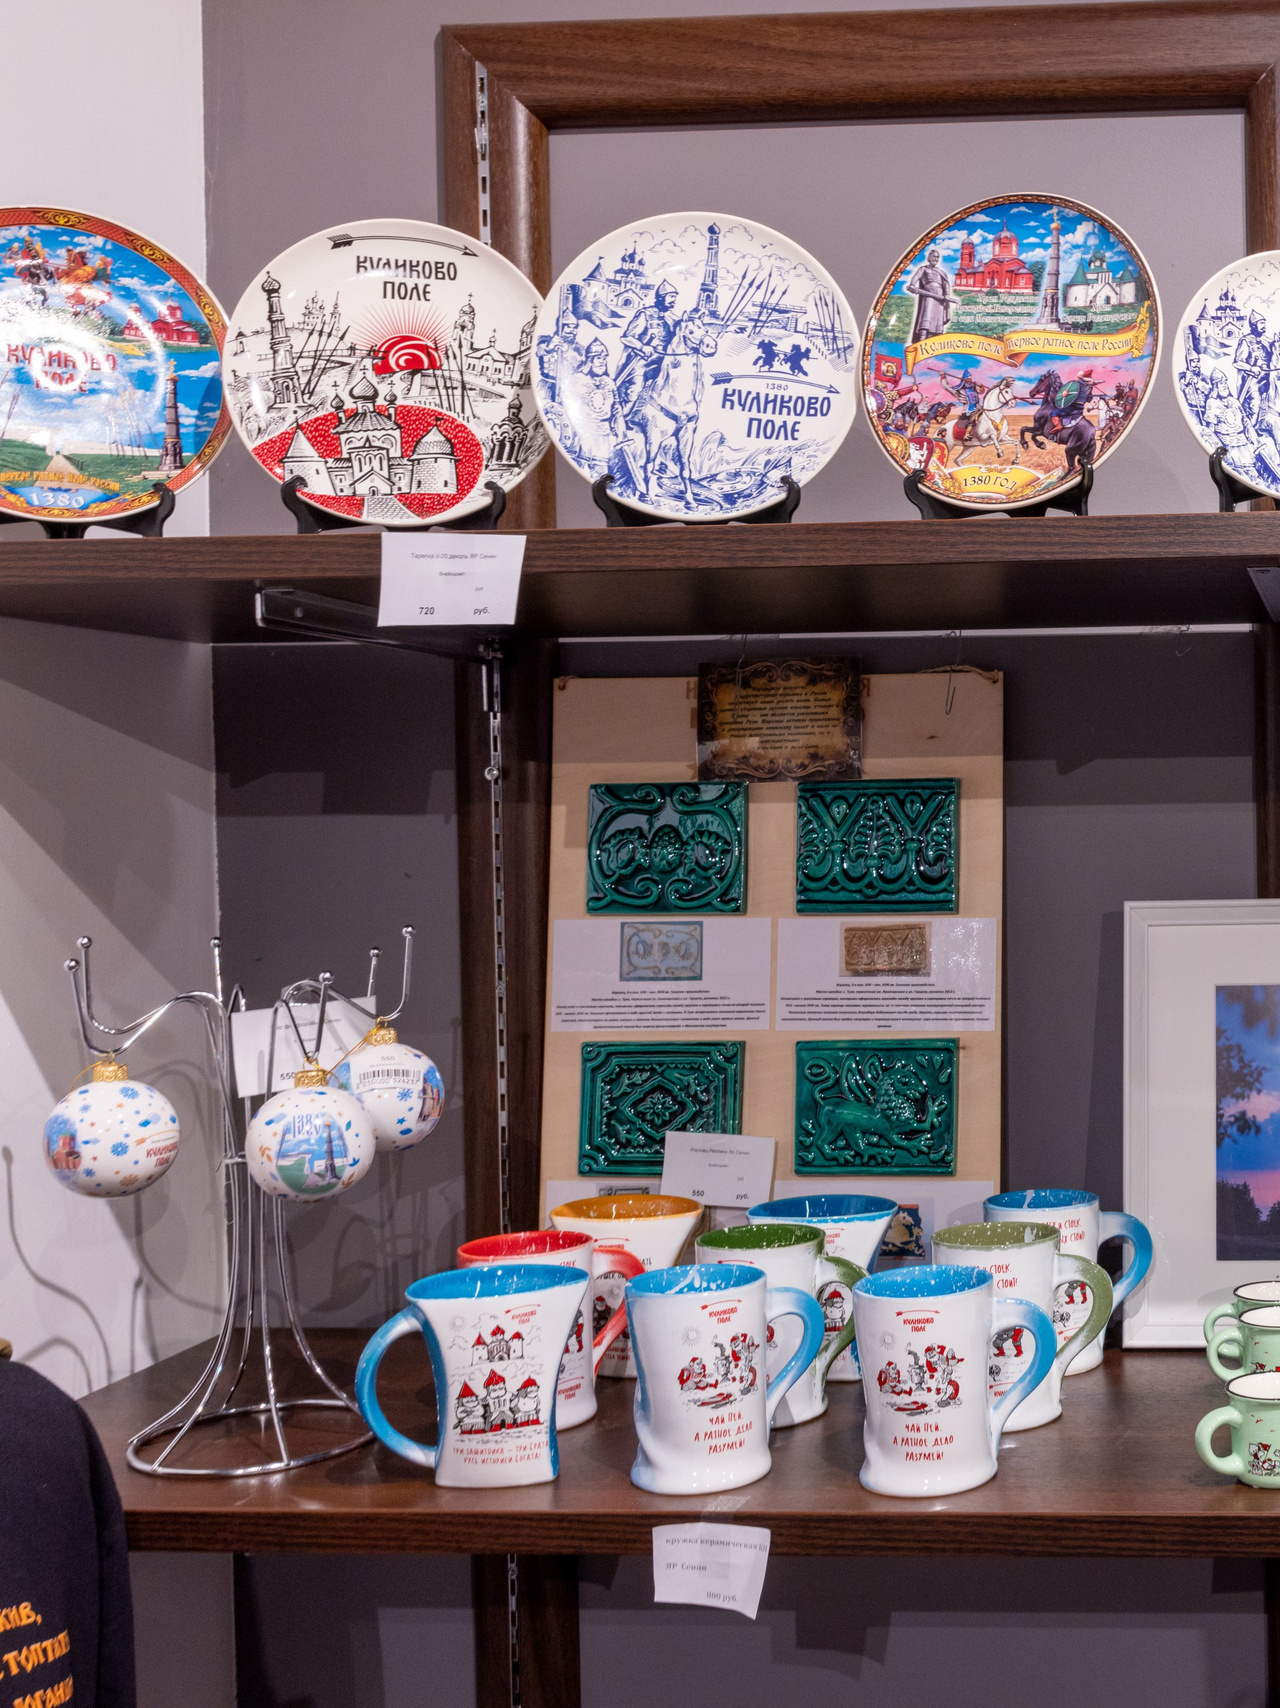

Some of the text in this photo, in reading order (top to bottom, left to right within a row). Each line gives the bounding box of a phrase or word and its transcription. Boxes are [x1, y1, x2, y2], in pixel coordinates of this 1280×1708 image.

[356, 255, 457, 281] КУЛИКОВО
[383, 281, 431, 301] ПОЛЕ
[920, 340, 1004, 356] Куликово поле
[1042, 338, 1075, 350] ратное
[1077, 340, 1100, 351] поле
[1102, 337, 1134, 350] России
[7, 344, 118, 372] КУИКВО
[766, 382, 788, 391] 1380
[722, 388, 831, 417] КУЛИКОВО
[746, 417, 801, 441] ПОЛЕ
[963, 474, 1018, 492] 1380 ГОД
[30, 492, 85, 508] 1380
[418, 606, 490, 616] 720 руб.
[708, 1306, 738, 1318] КУЛИКОВО
[717, 1316, 731, 1324] ПОЛЕ
[903, 1317, 934, 1326] КУЛИКОВО
[694, 1420, 752, 1441] А РАТНОЕ ДЕЛО
[905, 1422, 920, 1433] ЧАЙ
[893, 1434, 954, 1447] А РАТНОЕ ДЕЛО
[666, 1538, 698, 1546] кружка
[700, 1538, 758, 1550] керамическая
[666, 1562, 706, 1572] ЯР Сенин
[706, 1591, 736, 1602] 800 руб
